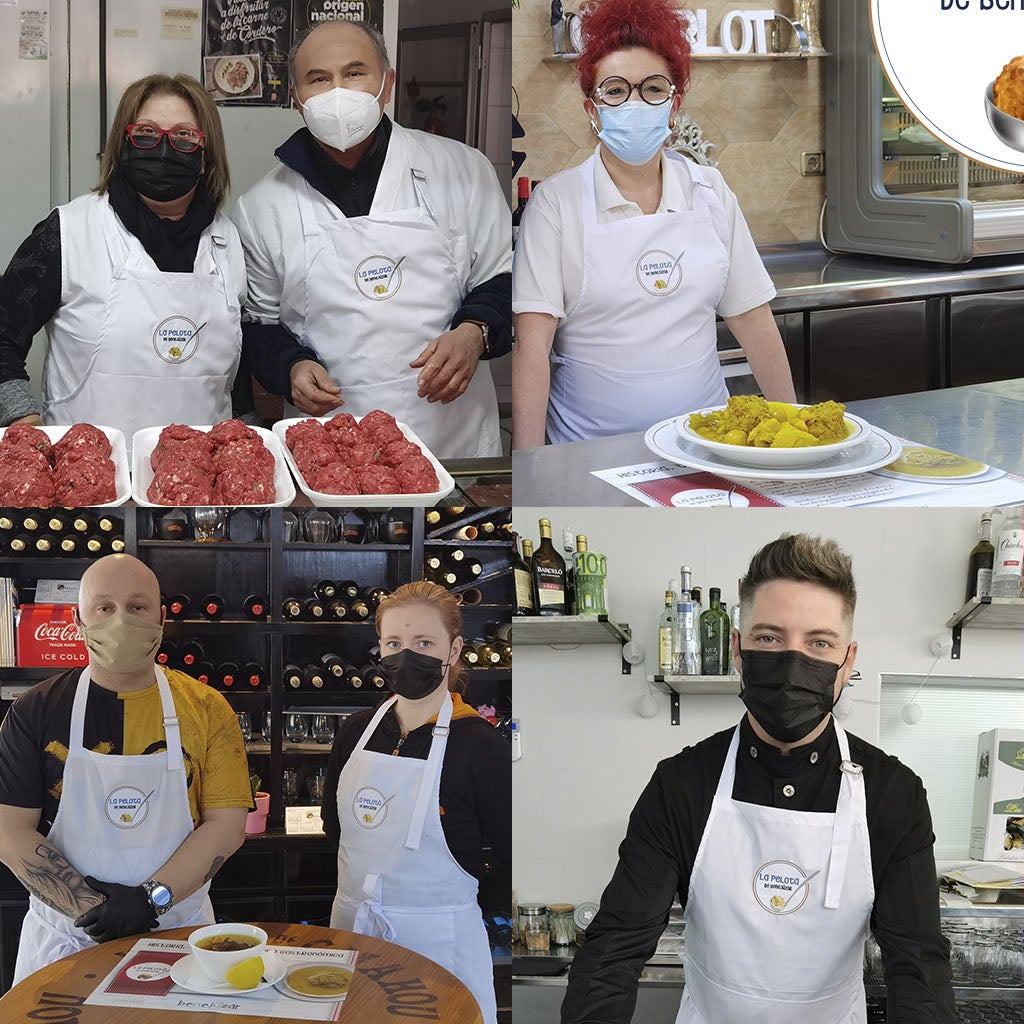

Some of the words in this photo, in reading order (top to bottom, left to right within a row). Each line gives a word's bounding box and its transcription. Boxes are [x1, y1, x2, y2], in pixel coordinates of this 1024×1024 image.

[323, 0, 364, 11] origen
[220, 19, 232, 29] de
[242, 11, 269, 24] carne
[311, 10, 364, 21] nacional
[537, 566, 563, 575] BARCELÓ
[41, 653, 57, 661] ICE
[60, 653, 86, 661] COLD
